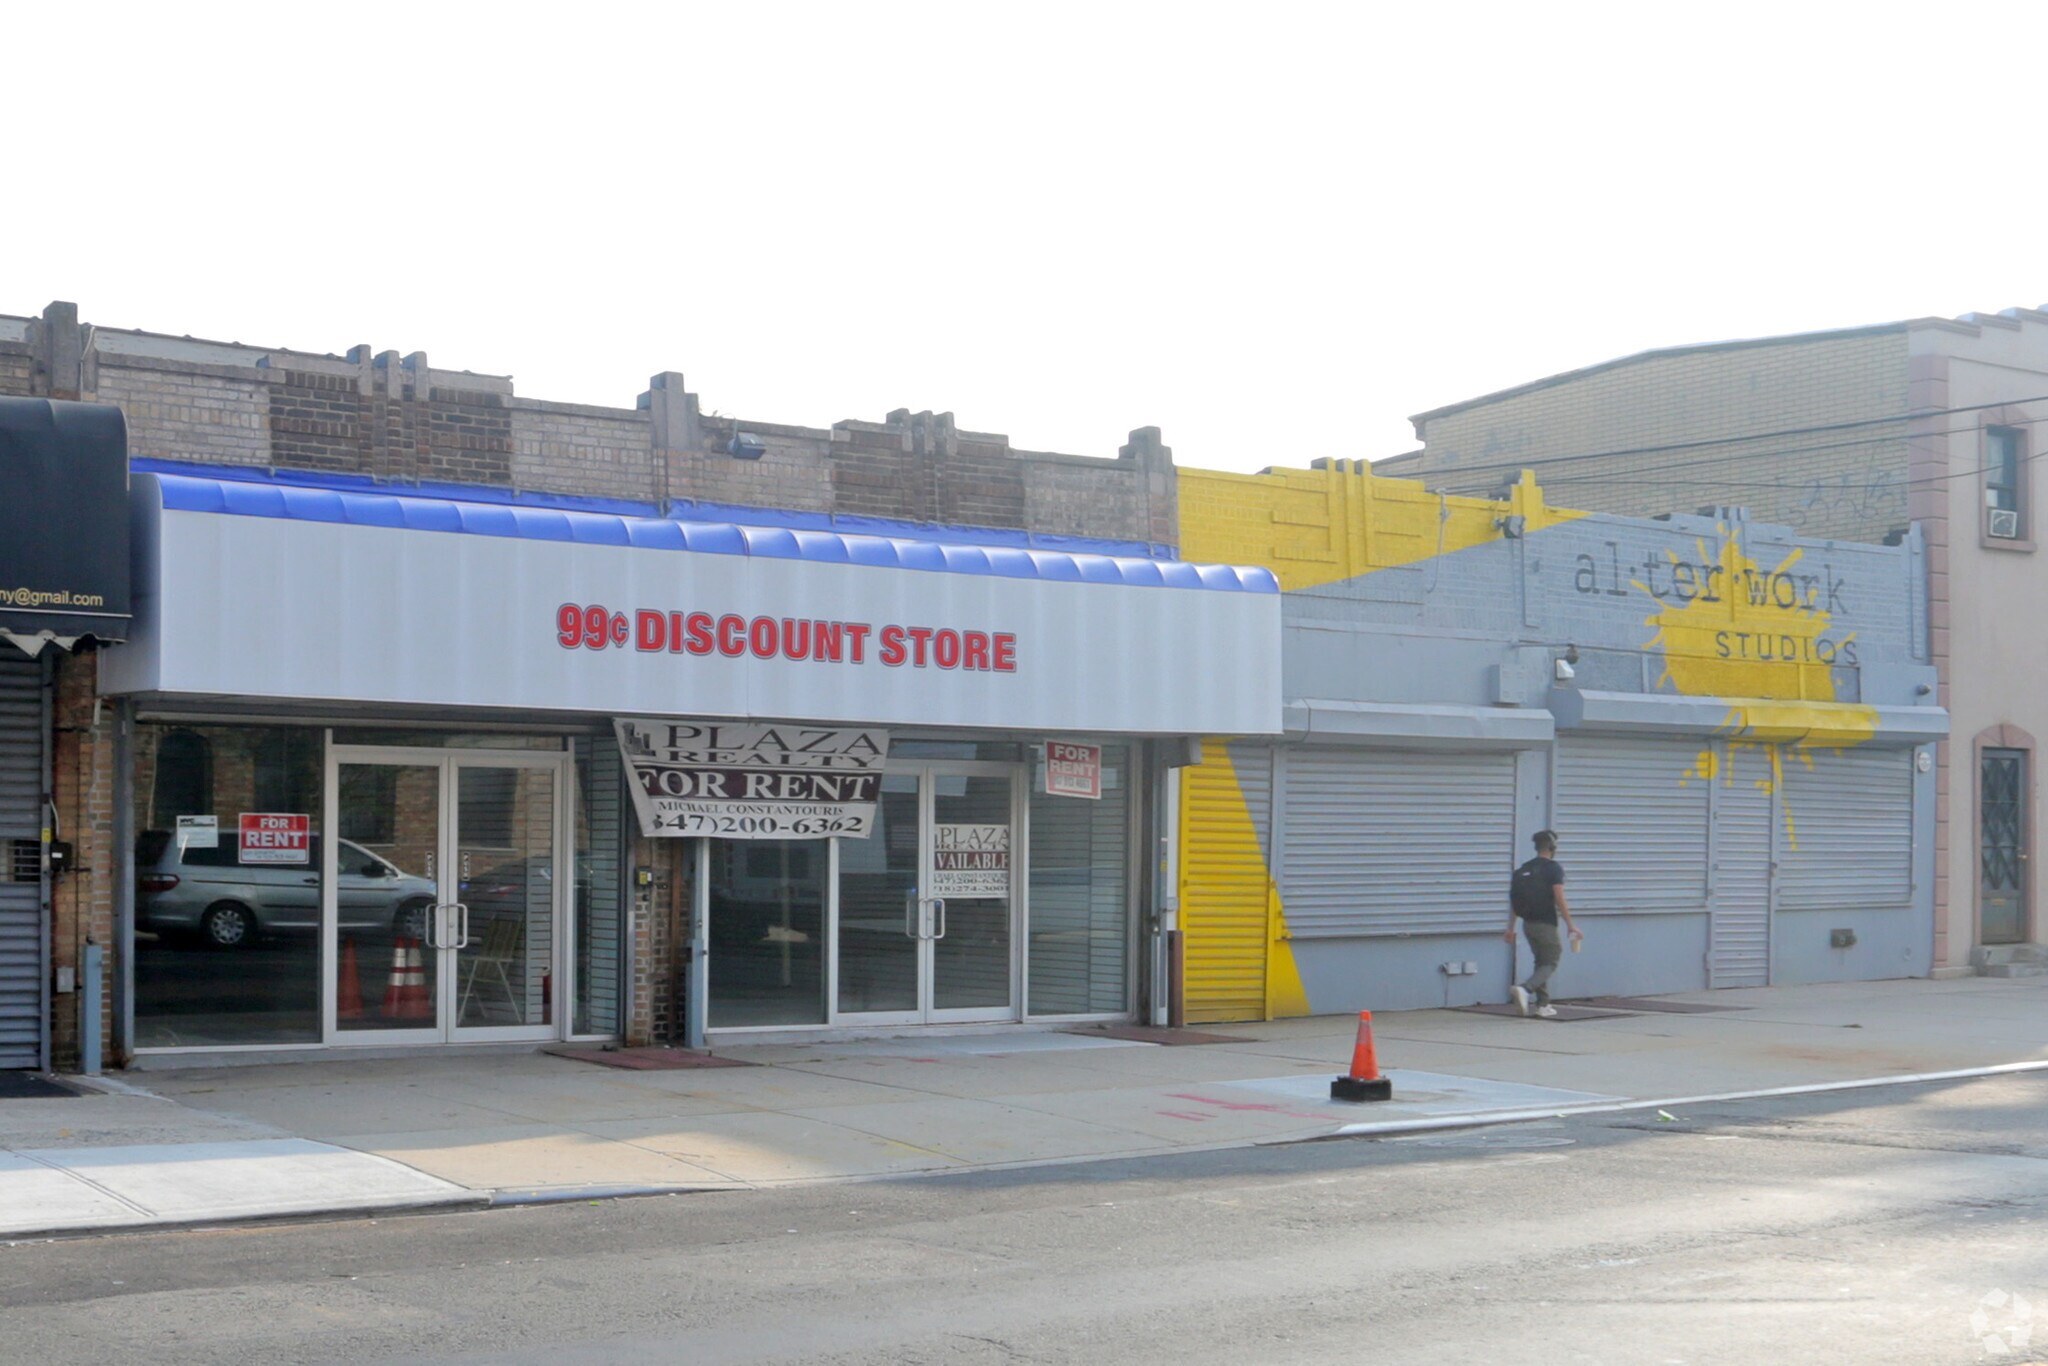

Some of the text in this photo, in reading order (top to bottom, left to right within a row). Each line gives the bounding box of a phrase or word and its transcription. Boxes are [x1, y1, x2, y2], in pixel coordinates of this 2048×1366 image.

[557, 603, 1017, 673] 99¢ DISCOUNT STORE
[1715, 631, 1858, 665] STUDIOS
[663, 725, 883, 755] PLAZA
[668, 751, 878, 768] REALTY
[1055, 745, 1090, 761] FOR
[1050, 759, 1096, 777] RENT
[743, 773, 874, 801] RENT
[658, 801, 843, 817] MICHAEL CONSTANTOURIS
[260, 818, 289, 829] FOR
[246, 831, 303, 847] RENT
[940, 826, 1009, 844] PLAZA
